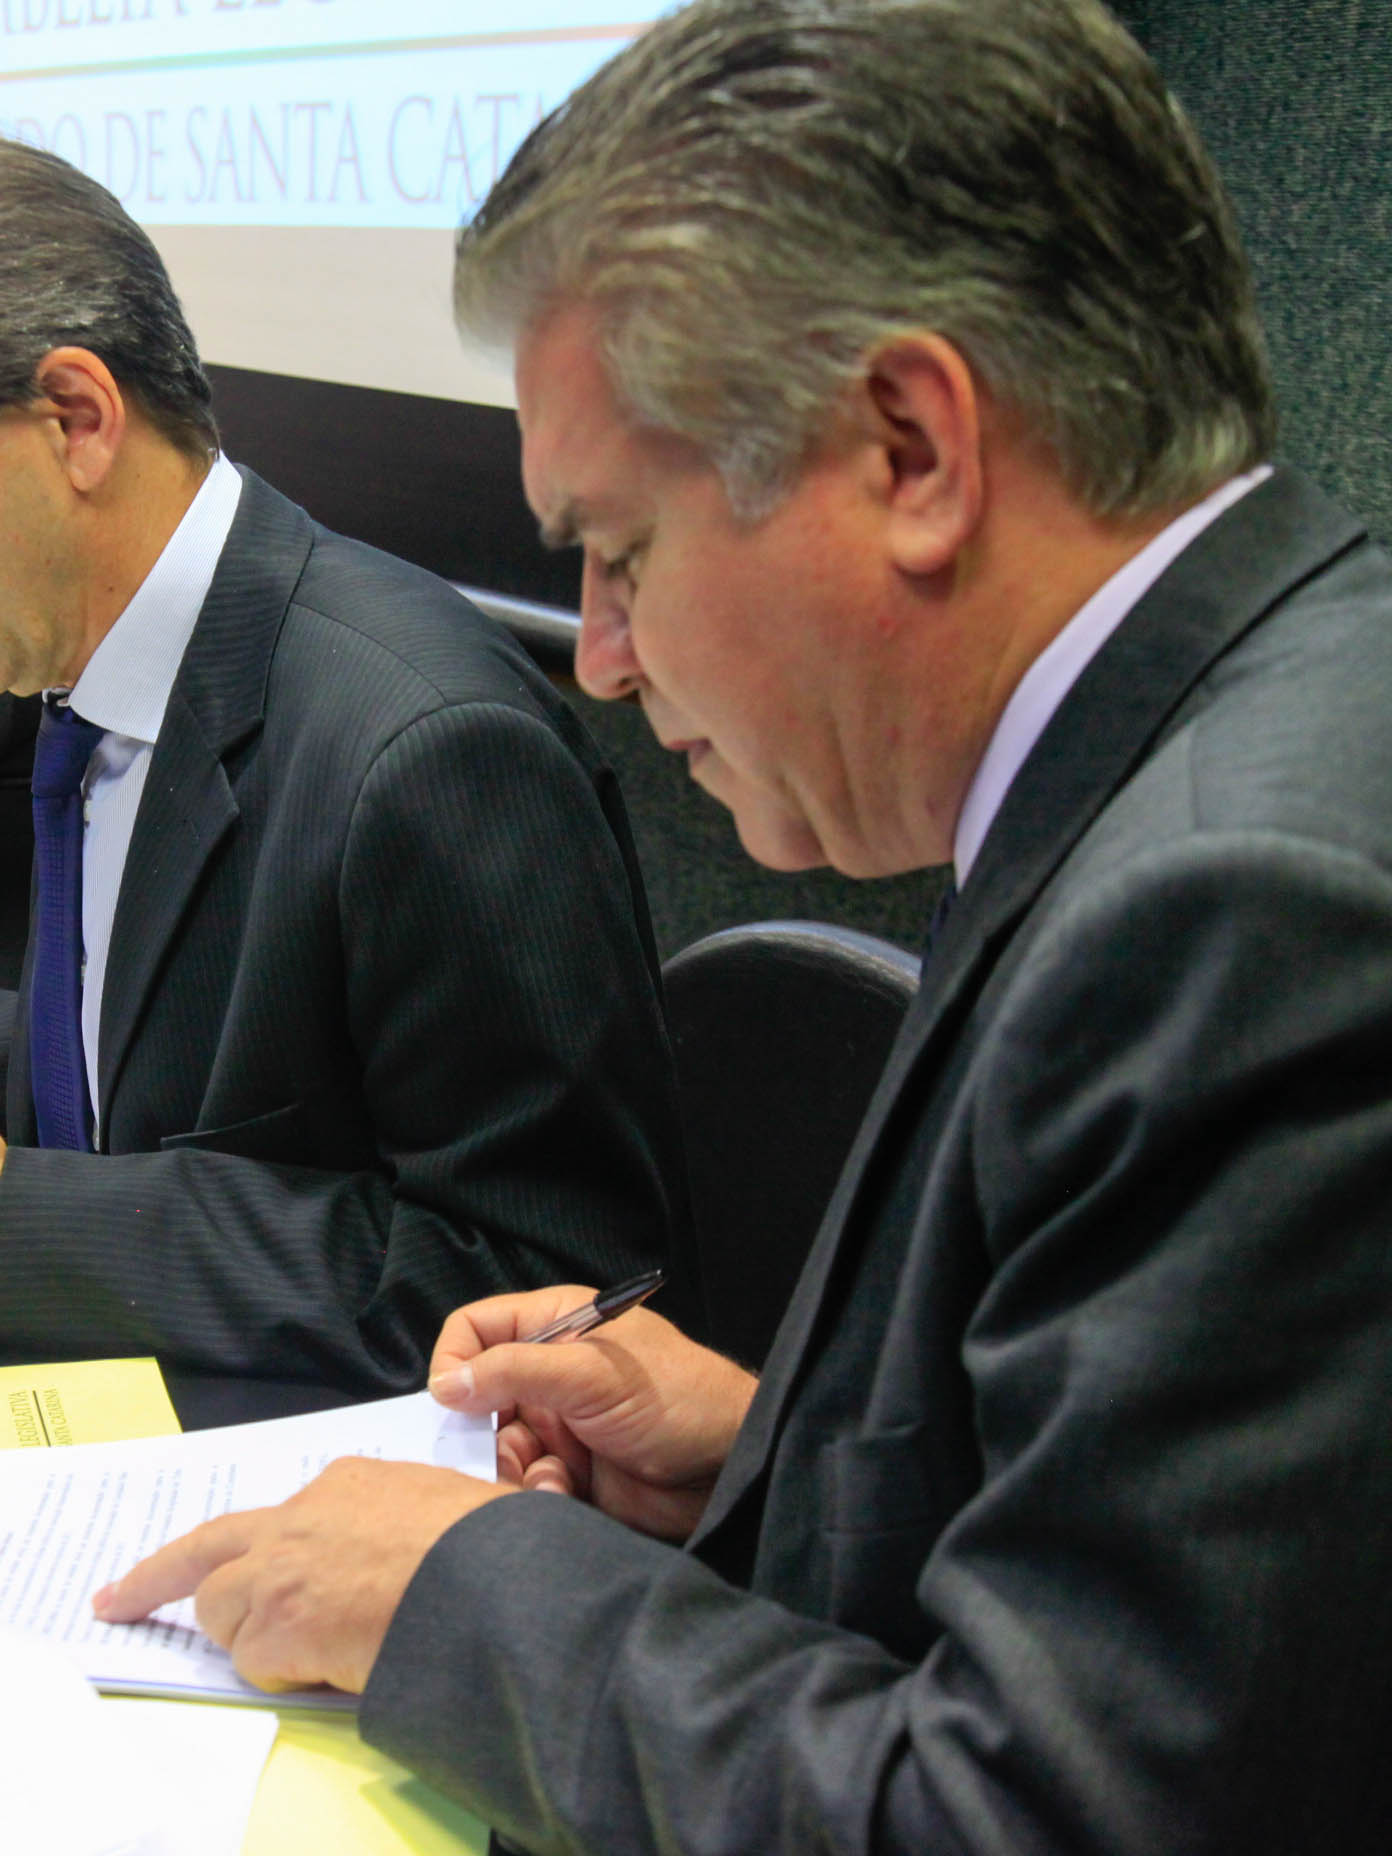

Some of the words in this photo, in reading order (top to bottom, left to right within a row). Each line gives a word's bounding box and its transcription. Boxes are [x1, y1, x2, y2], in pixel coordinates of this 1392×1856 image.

[104, 109, 166, 203] DE
[183, 99, 374, 204] SANTA
[386, 92, 544, 204] CAT
